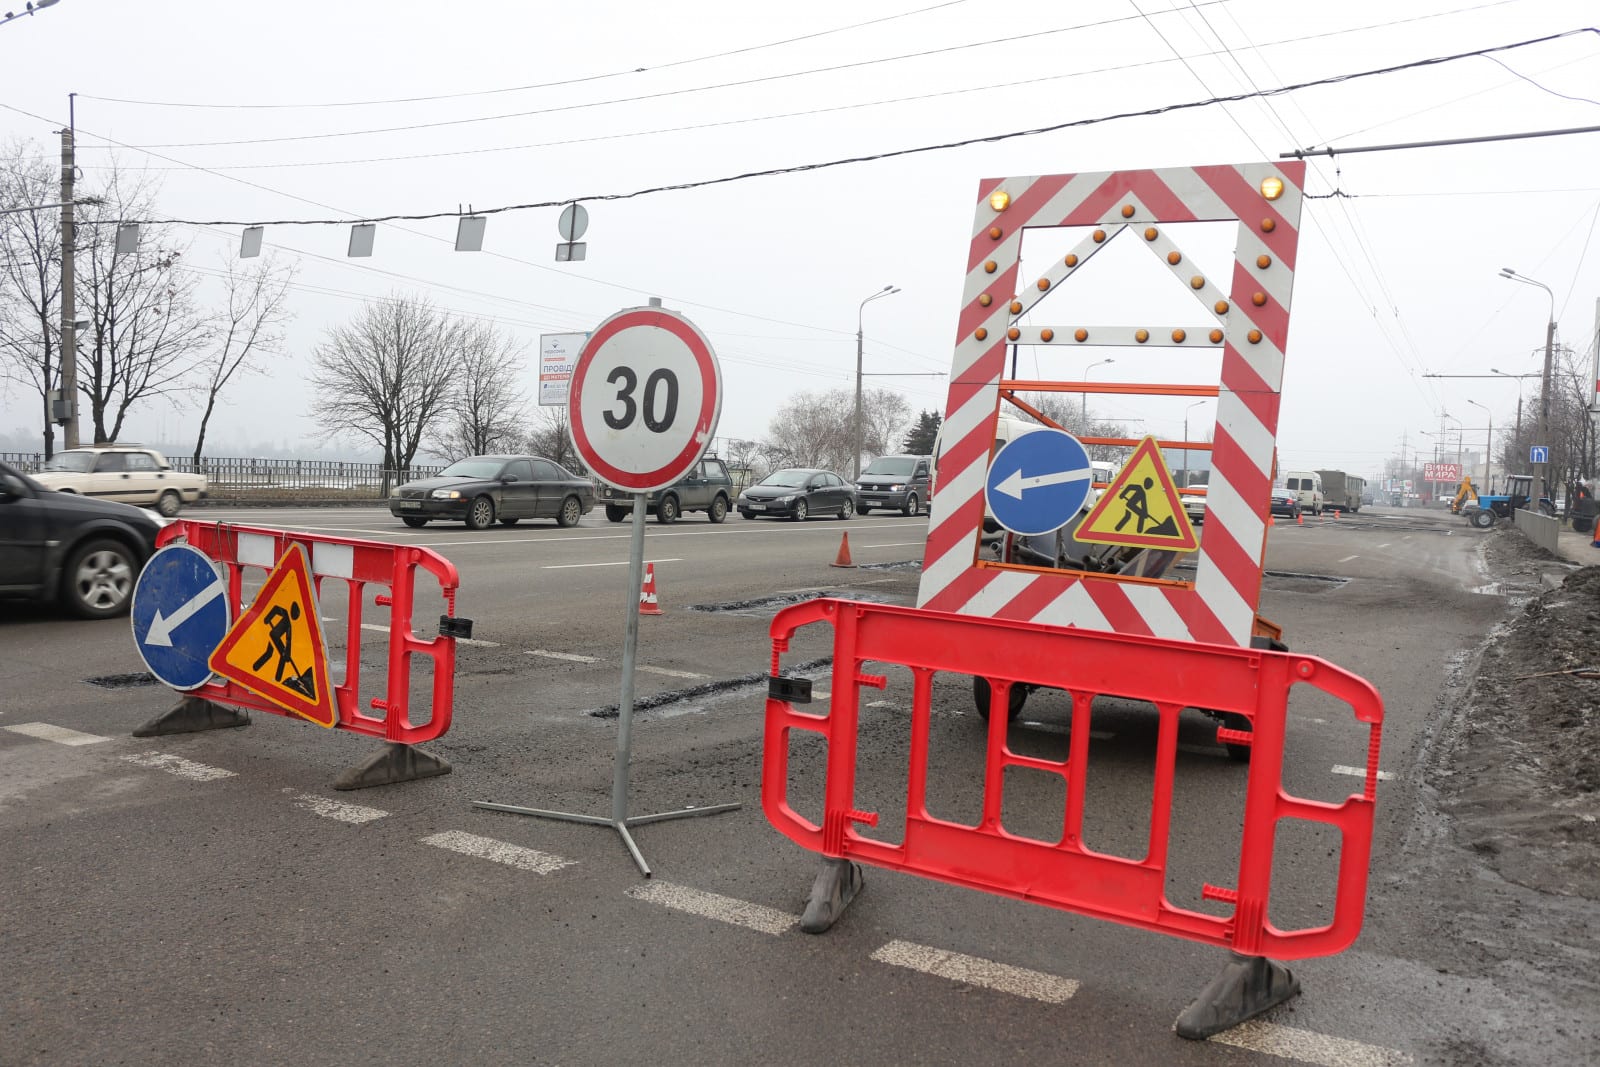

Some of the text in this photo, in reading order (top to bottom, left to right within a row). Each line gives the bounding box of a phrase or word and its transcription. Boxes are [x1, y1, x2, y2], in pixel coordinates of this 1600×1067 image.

[602, 365, 679, 433] 30
[1425, 463, 1456, 472] ВИНА
[1425, 471, 1456, 479] МИРА
